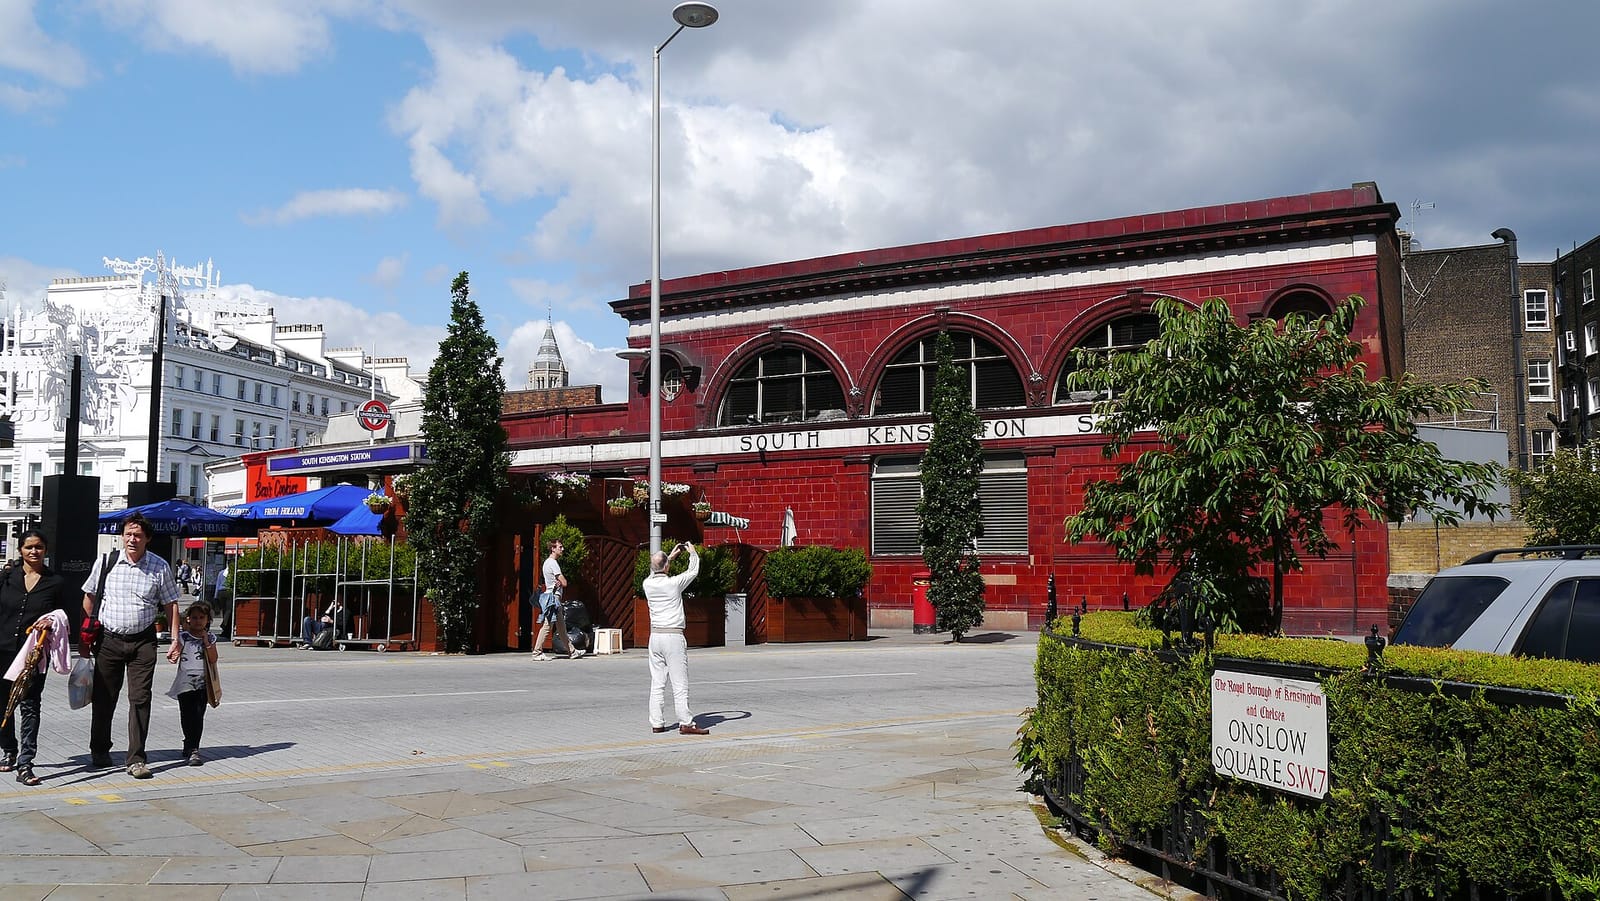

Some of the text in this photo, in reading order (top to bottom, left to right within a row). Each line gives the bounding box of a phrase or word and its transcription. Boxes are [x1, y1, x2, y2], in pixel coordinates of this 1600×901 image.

[740, 419, 1026, 451] SOUTH KENSTON
[301, 452, 371, 466] SOUTH KENSINGTON STATION
[264, 506, 305, 516] FROM HOLLAND
[1215, 678, 1322, 708] The Royal Borough of Kensington
[1246, 704, 1286, 722] and Chelsea
[1228, 719, 1307, 756] ONSLOW
[1286, 762, 1327, 794] S.W.7
